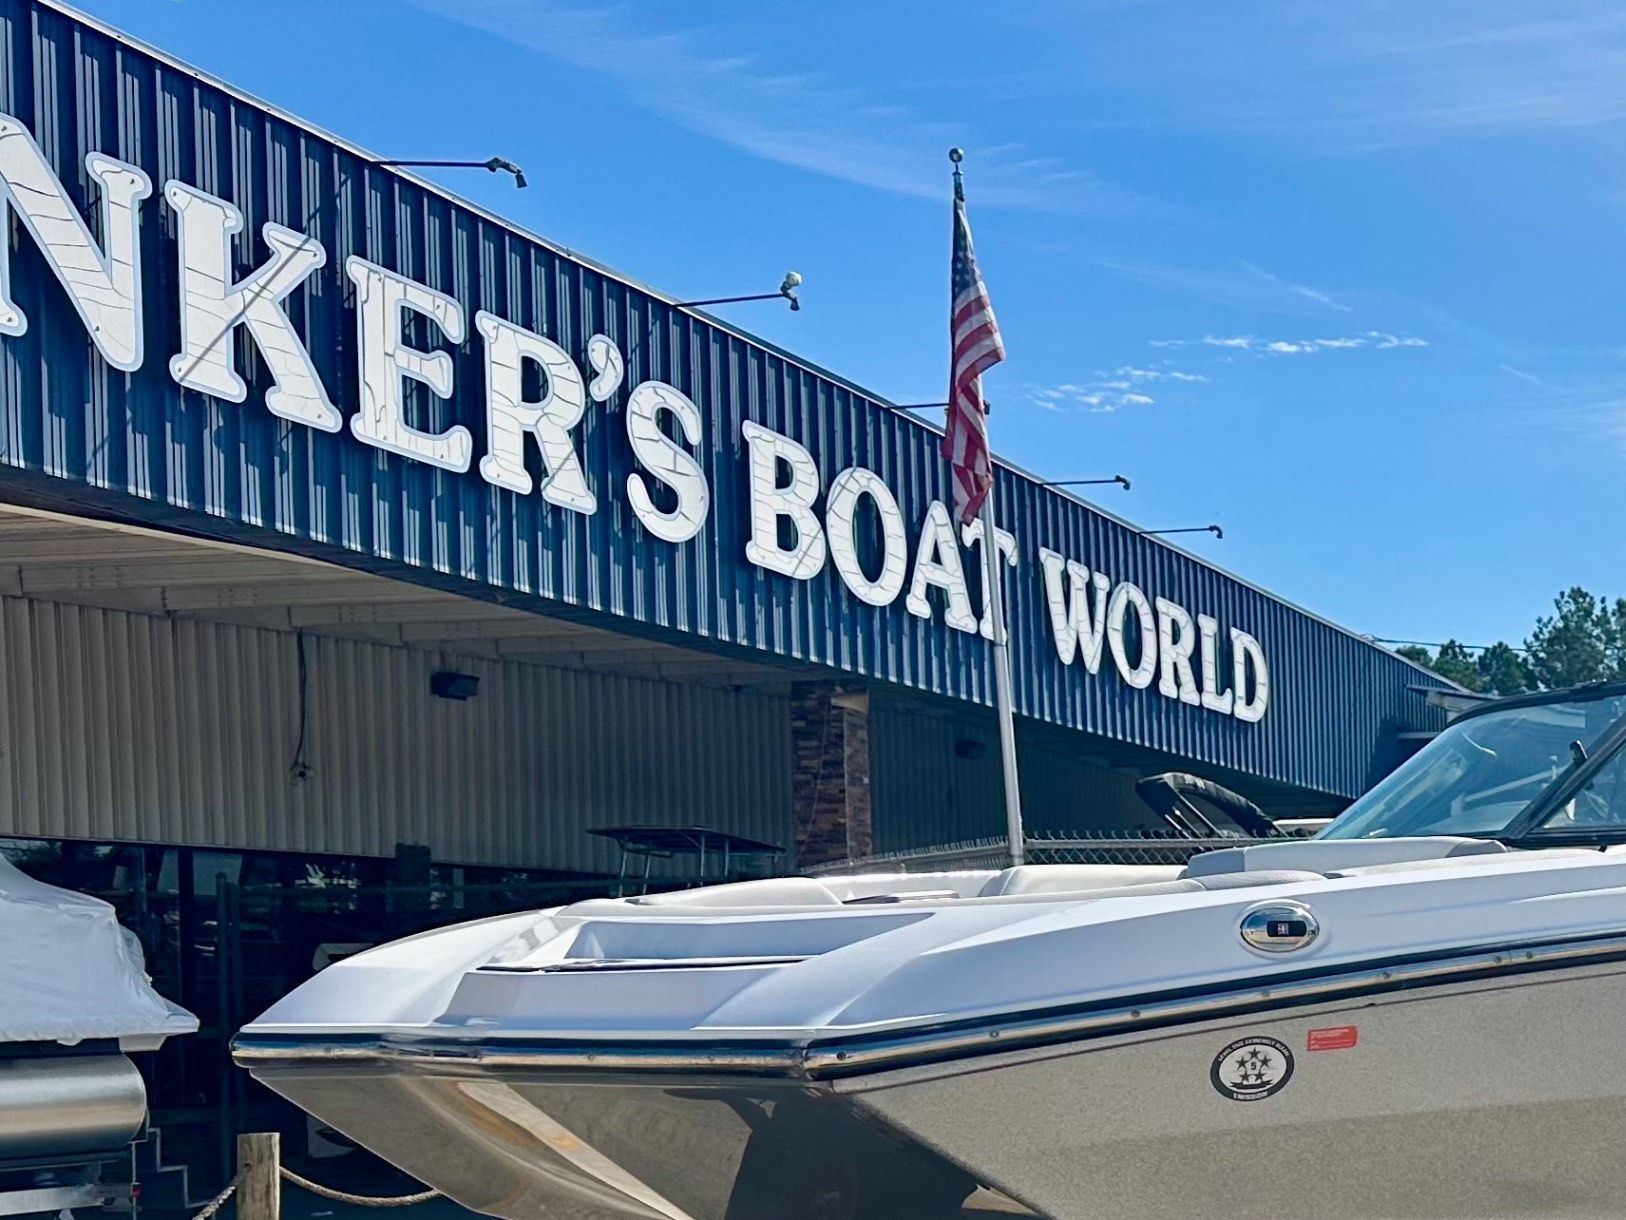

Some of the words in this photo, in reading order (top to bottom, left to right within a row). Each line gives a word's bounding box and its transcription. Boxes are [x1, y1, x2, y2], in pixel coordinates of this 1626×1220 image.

[0, 112, 710, 543] NKER'S
[742, 418, 1018, 646] BOAT
[1038, 546, 1268, 723] WORLD
